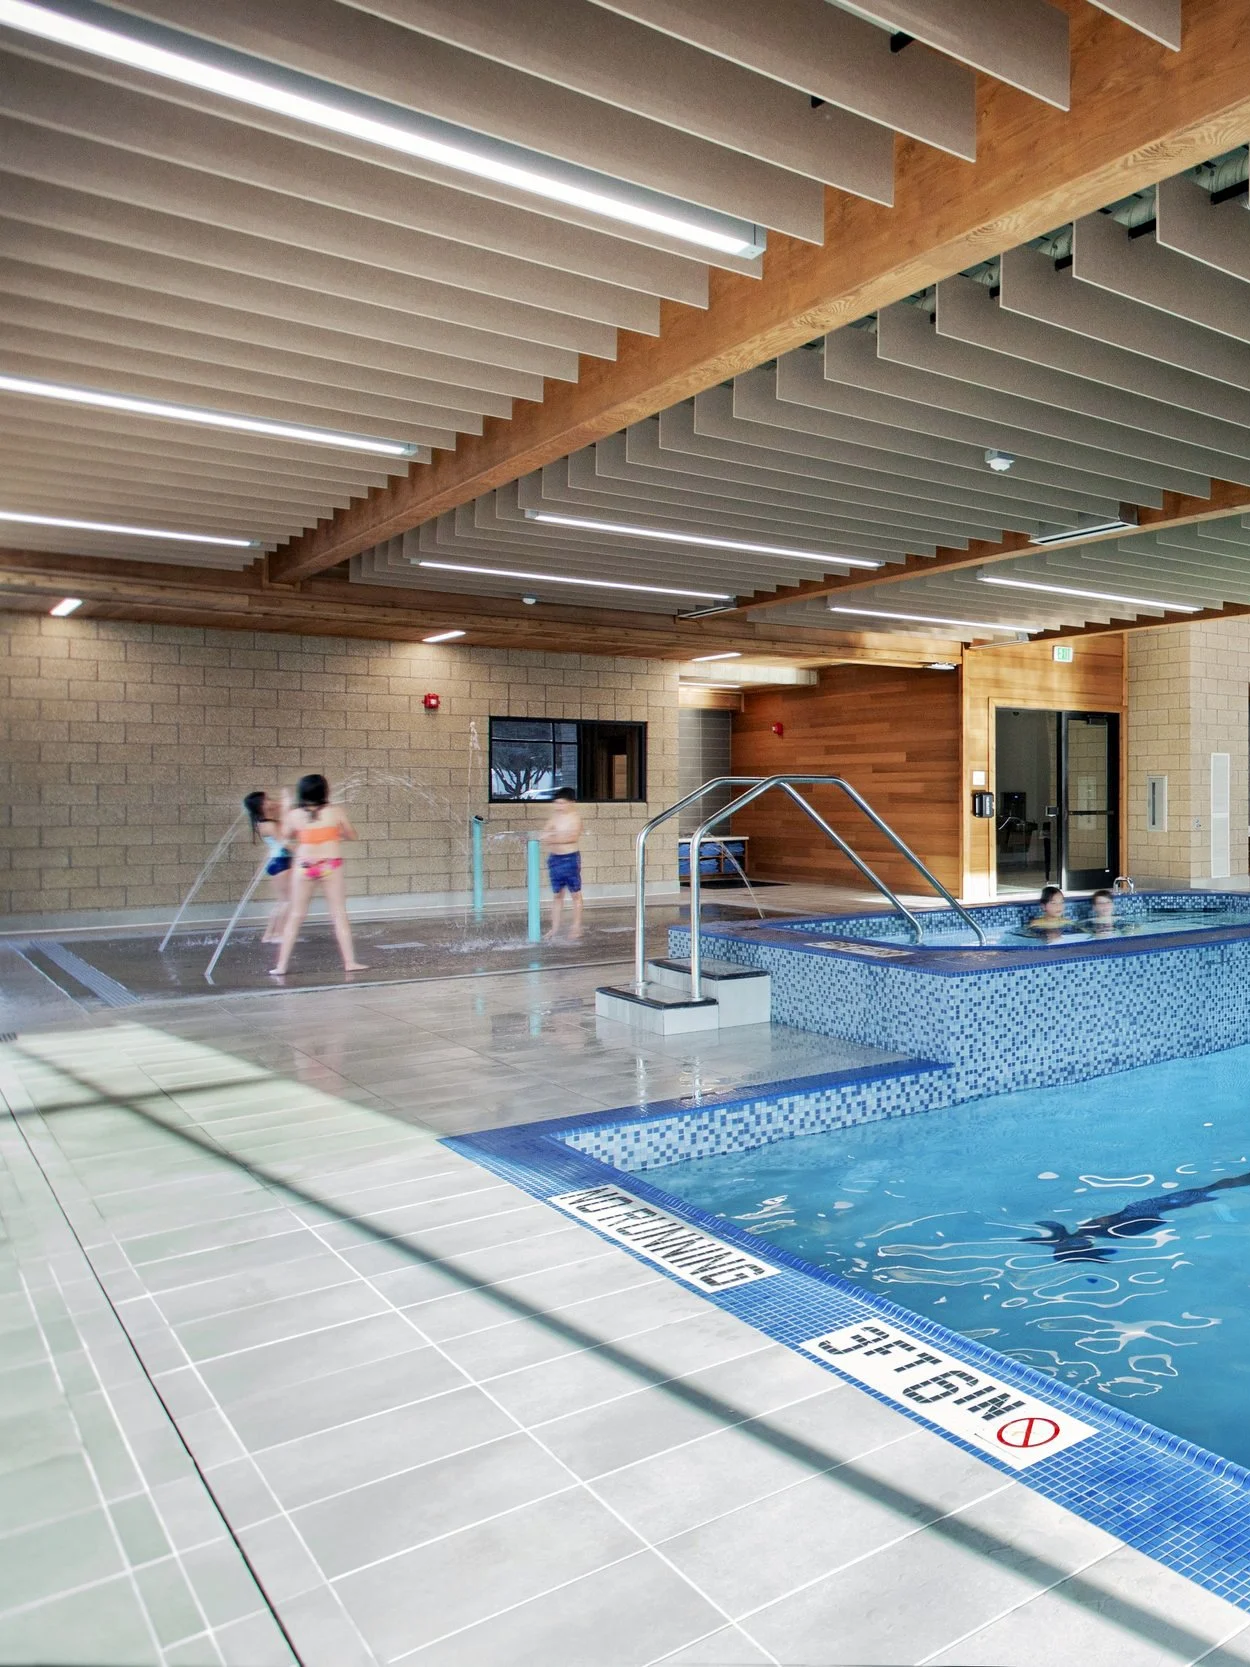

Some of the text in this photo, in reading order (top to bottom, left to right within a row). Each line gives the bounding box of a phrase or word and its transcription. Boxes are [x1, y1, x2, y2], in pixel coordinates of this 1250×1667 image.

[1057, 647, 1071, 660] EXIT
[560, 1187, 765, 1287] NO RUNNING
